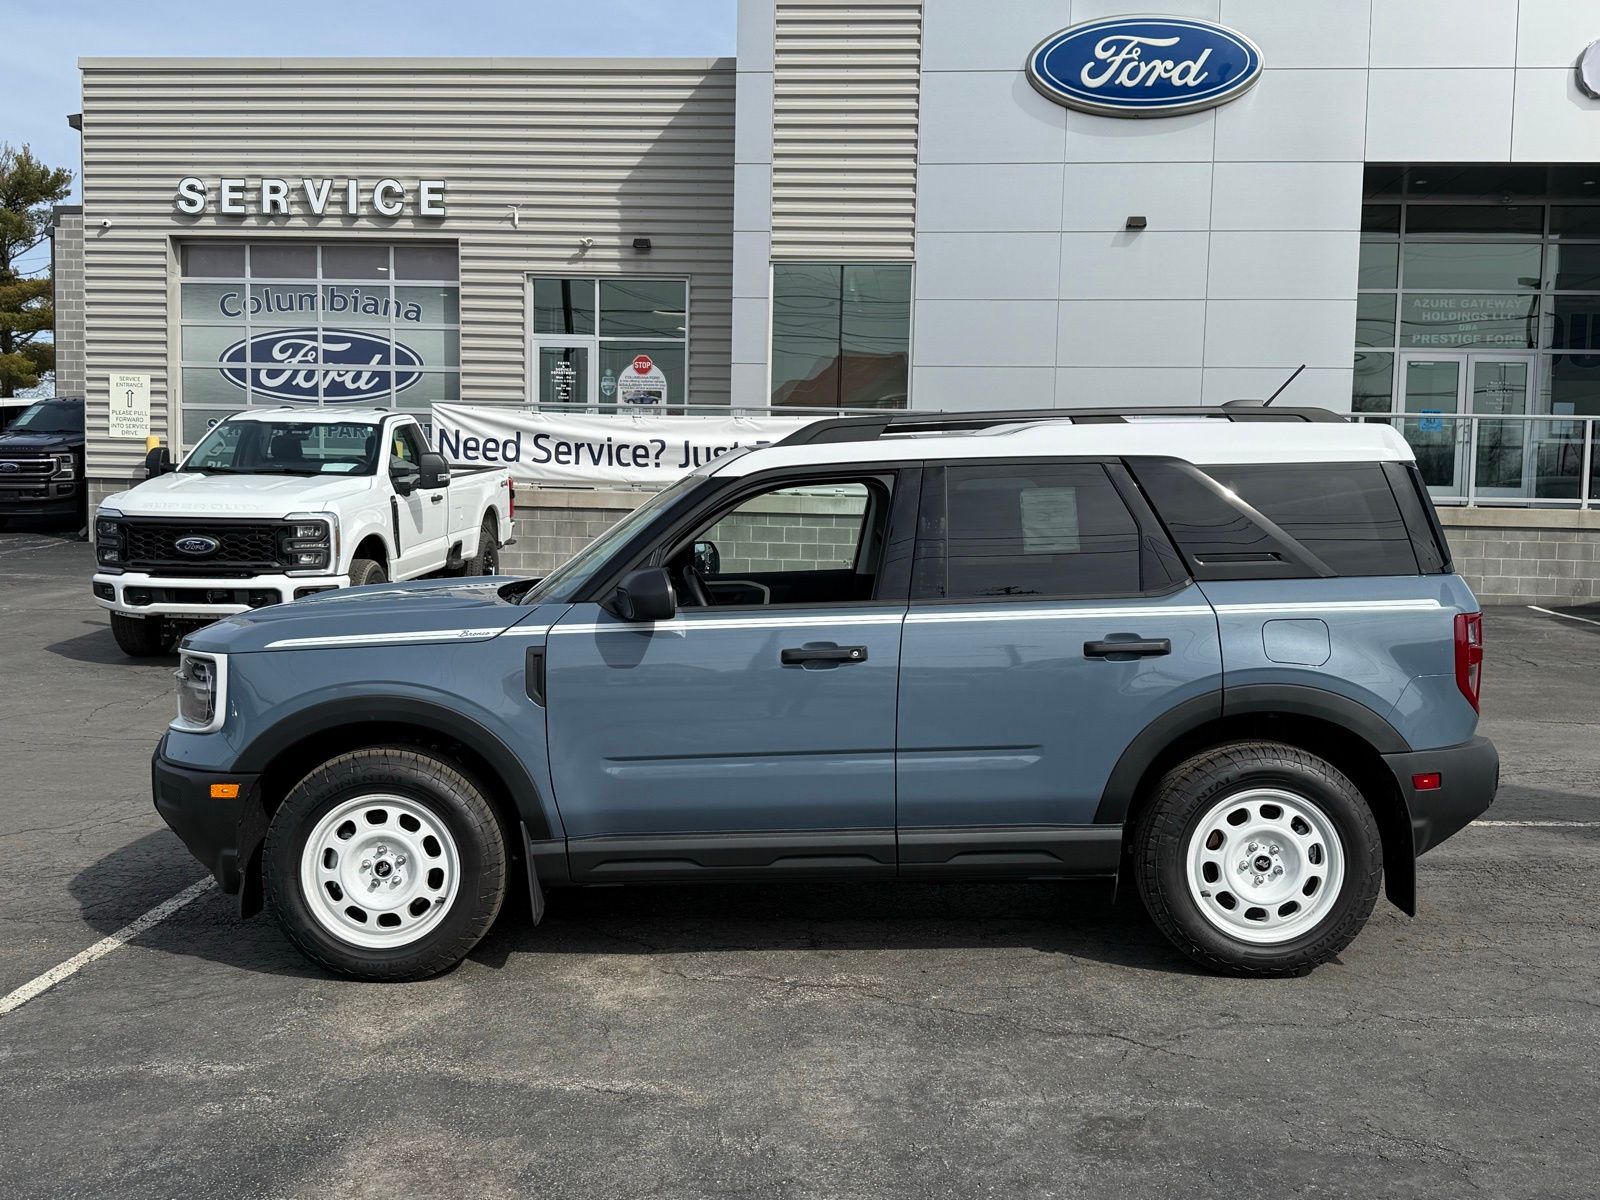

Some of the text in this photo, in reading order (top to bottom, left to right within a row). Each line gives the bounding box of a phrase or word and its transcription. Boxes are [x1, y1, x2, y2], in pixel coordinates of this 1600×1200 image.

[1081, 35, 1213, 88] Ford
[177, 176, 446, 216] SERVICE
[219, 287, 423, 323] Columbiana
[1413, 298, 1522, 308] AZURE GATEWAY
[1422, 311, 1488, 321] HOLDINGS
[1412, 334, 1524, 344] PRESTIGE FORD
[259, 339, 382, 390] Ford
[634, 361, 651, 369] STOP
[439, 428, 521, 463] Need
[532, 432, 666, 469] Service?
[457, 630, 491, 638] Bronco
